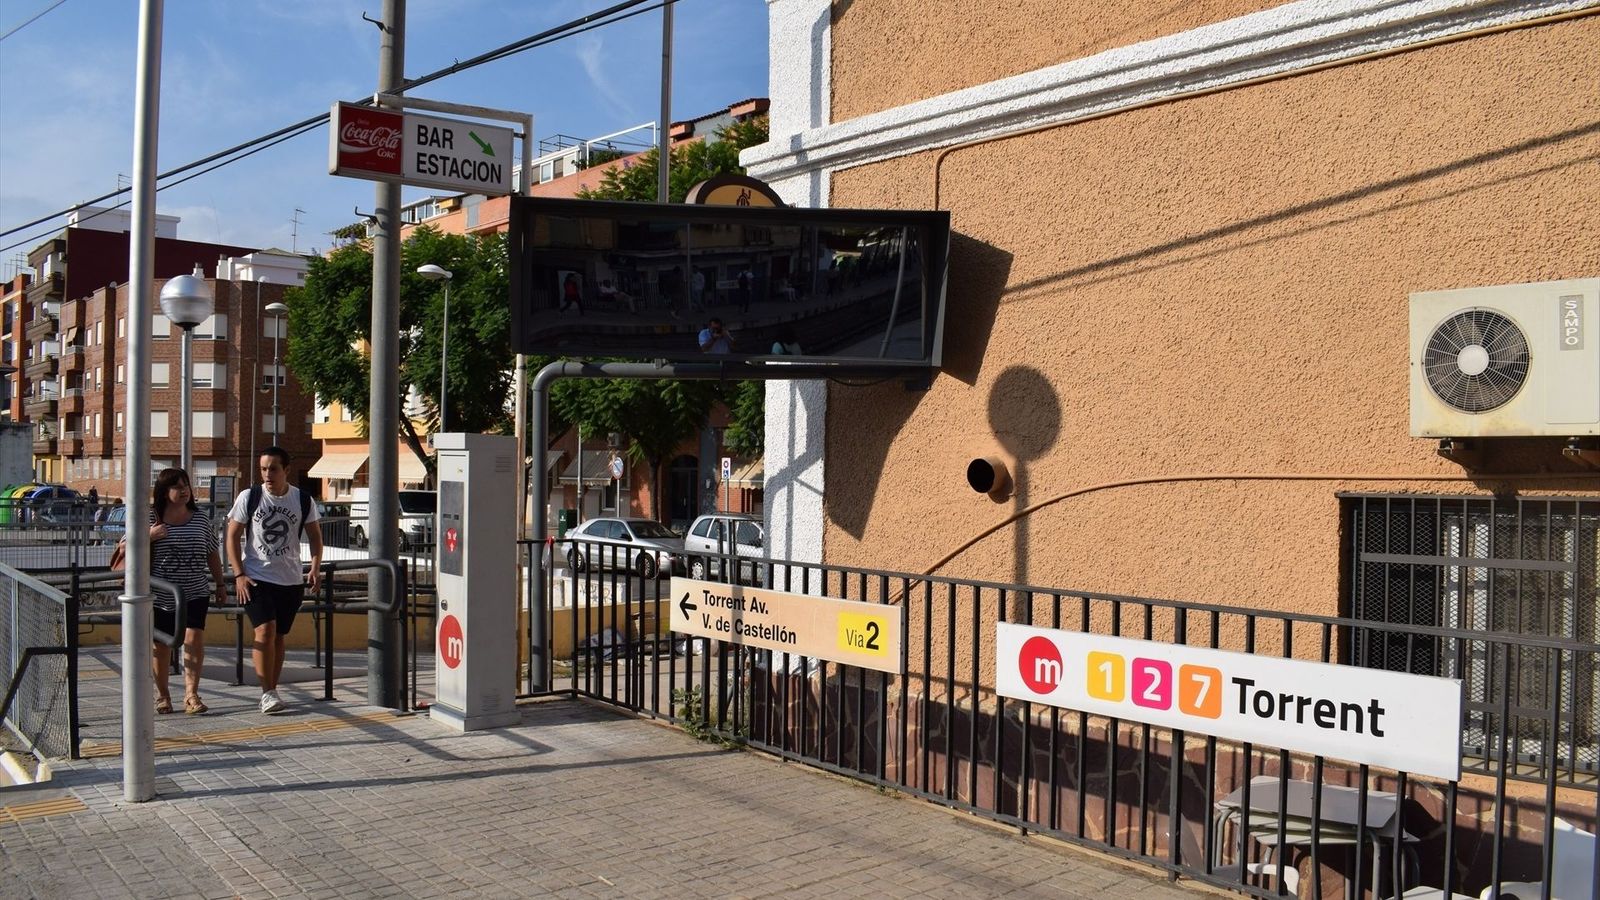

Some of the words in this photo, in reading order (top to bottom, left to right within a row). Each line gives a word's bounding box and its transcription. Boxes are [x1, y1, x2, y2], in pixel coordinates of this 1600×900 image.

[417, 124, 454, 150] BAR
[377, 148, 396, 159] Coke
[417, 152, 502, 184] ESTACION
[1564, 300, 1578, 345] SAMPO
[254, 509, 266, 522] LOS
[258, 545, 271, 556] ALL
[275, 545, 290, 557] CITY
[703, 590, 746, 612] Torrent
[750, 597, 769, 614] Av.
[702, 613, 712, 630] V.
[715, 616, 731, 633] de
[735, 619, 797, 645] Castellón
[846, 628, 864, 648] Via
[866, 621, 880, 650] 2
[1098, 661, 1113, 693] 1
[1143, 667, 1162, 702] 2
[1191, 674, 1212, 709] 7
[1232, 677, 1386, 738] Torrent
